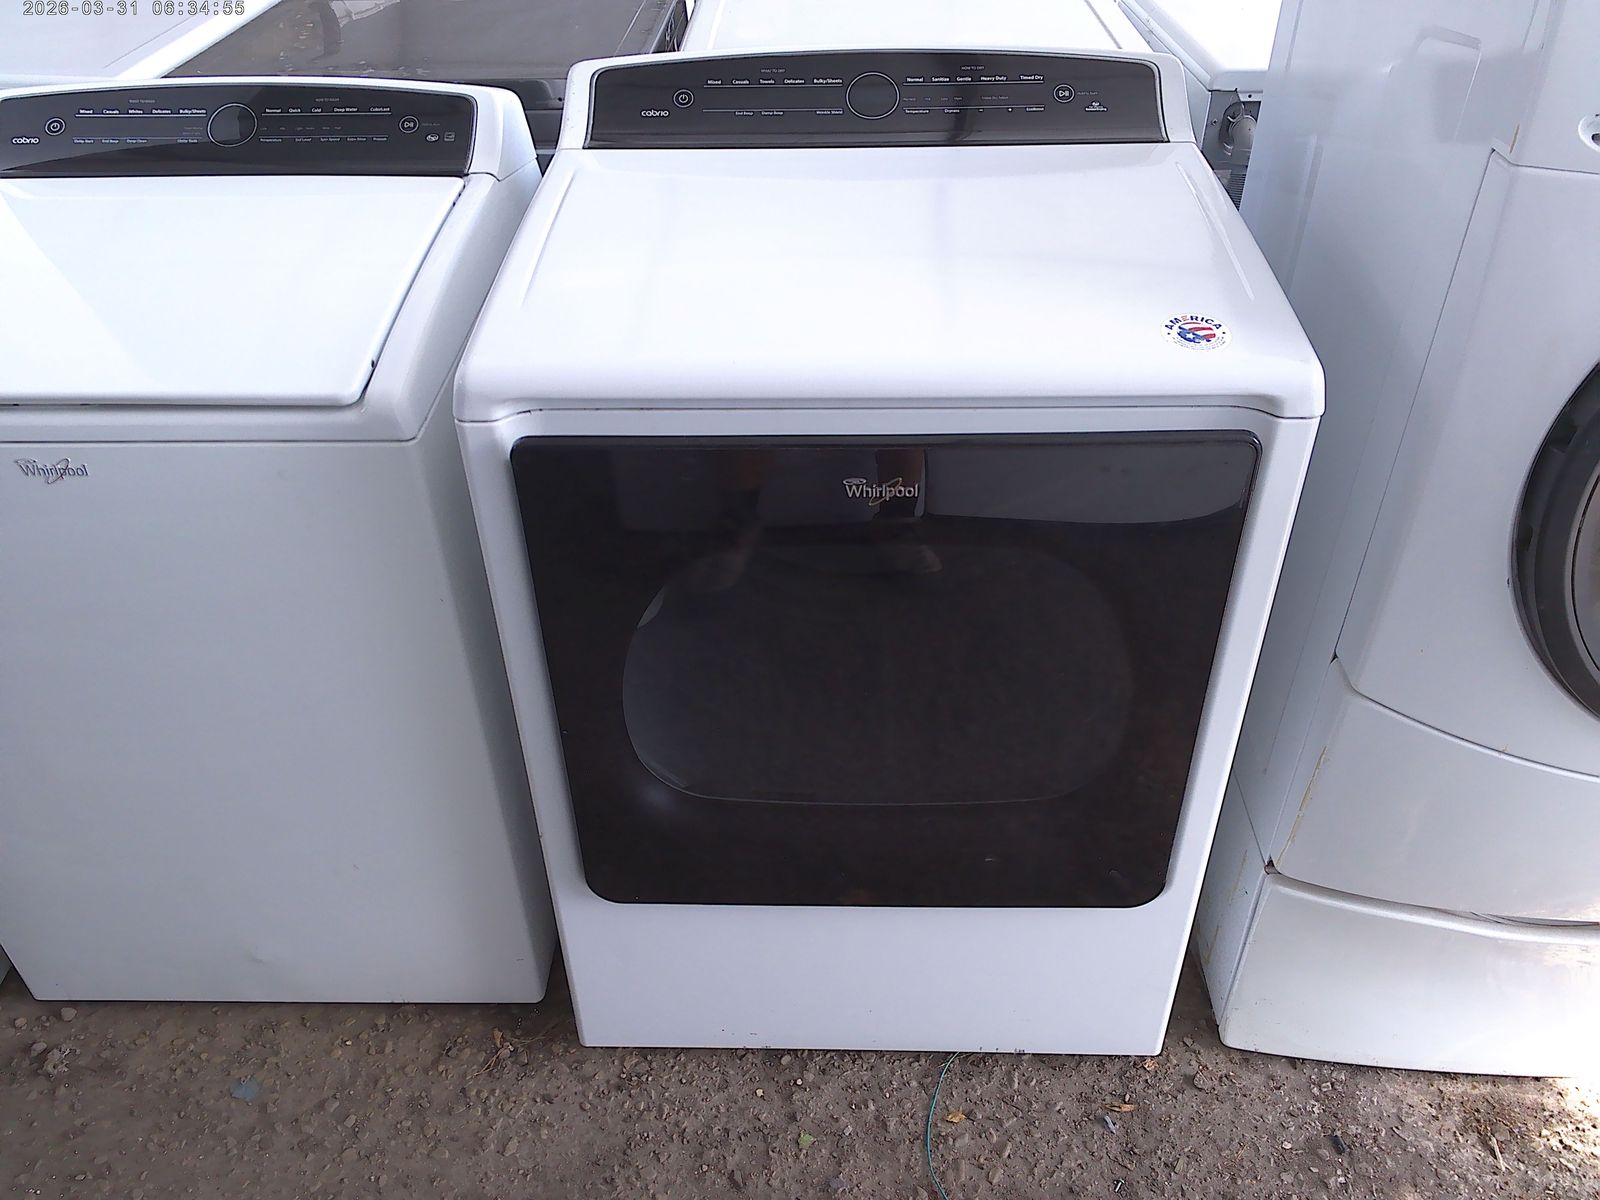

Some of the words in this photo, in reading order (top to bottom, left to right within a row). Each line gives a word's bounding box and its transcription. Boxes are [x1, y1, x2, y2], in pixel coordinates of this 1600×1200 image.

[641, 108, 670, 118] cabrio
[12, 136, 40, 144] cabrio
[1165, 315, 1222, 330] AMERICA
[20, 463, 88, 479] Whirlpool
[845, 483, 918, 501] Whirlpool
